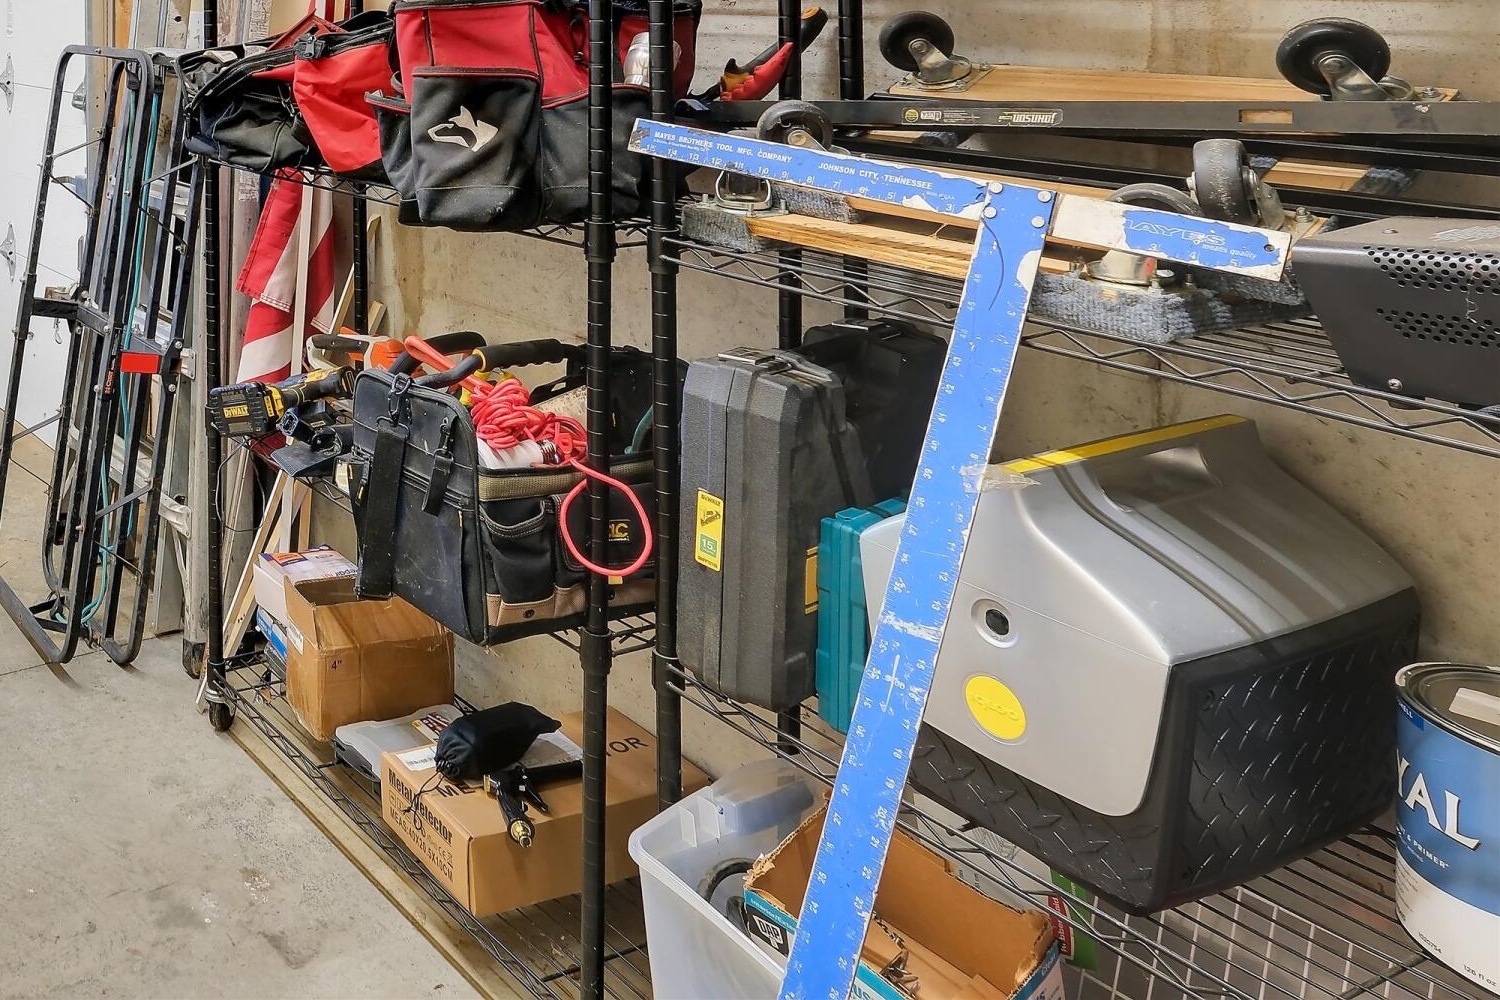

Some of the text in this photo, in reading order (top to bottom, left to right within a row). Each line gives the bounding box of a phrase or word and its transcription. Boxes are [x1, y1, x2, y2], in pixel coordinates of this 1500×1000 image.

[654, 131, 676, 141] MAYES
[678, 136, 714, 149] BROTHERS
[716, 143, 734, 152] TOOL
[736, 147, 754, 157] MFG.
[757, 150, 793, 164] COMPANY
[818, 161, 856, 176] JOHNSON
[883, 174, 934, 190] TENNESSEE
[1230, 249, 1257, 260] quality
[389, 767, 415, 803] Metal
[759, 920, 781, 939] DAP
